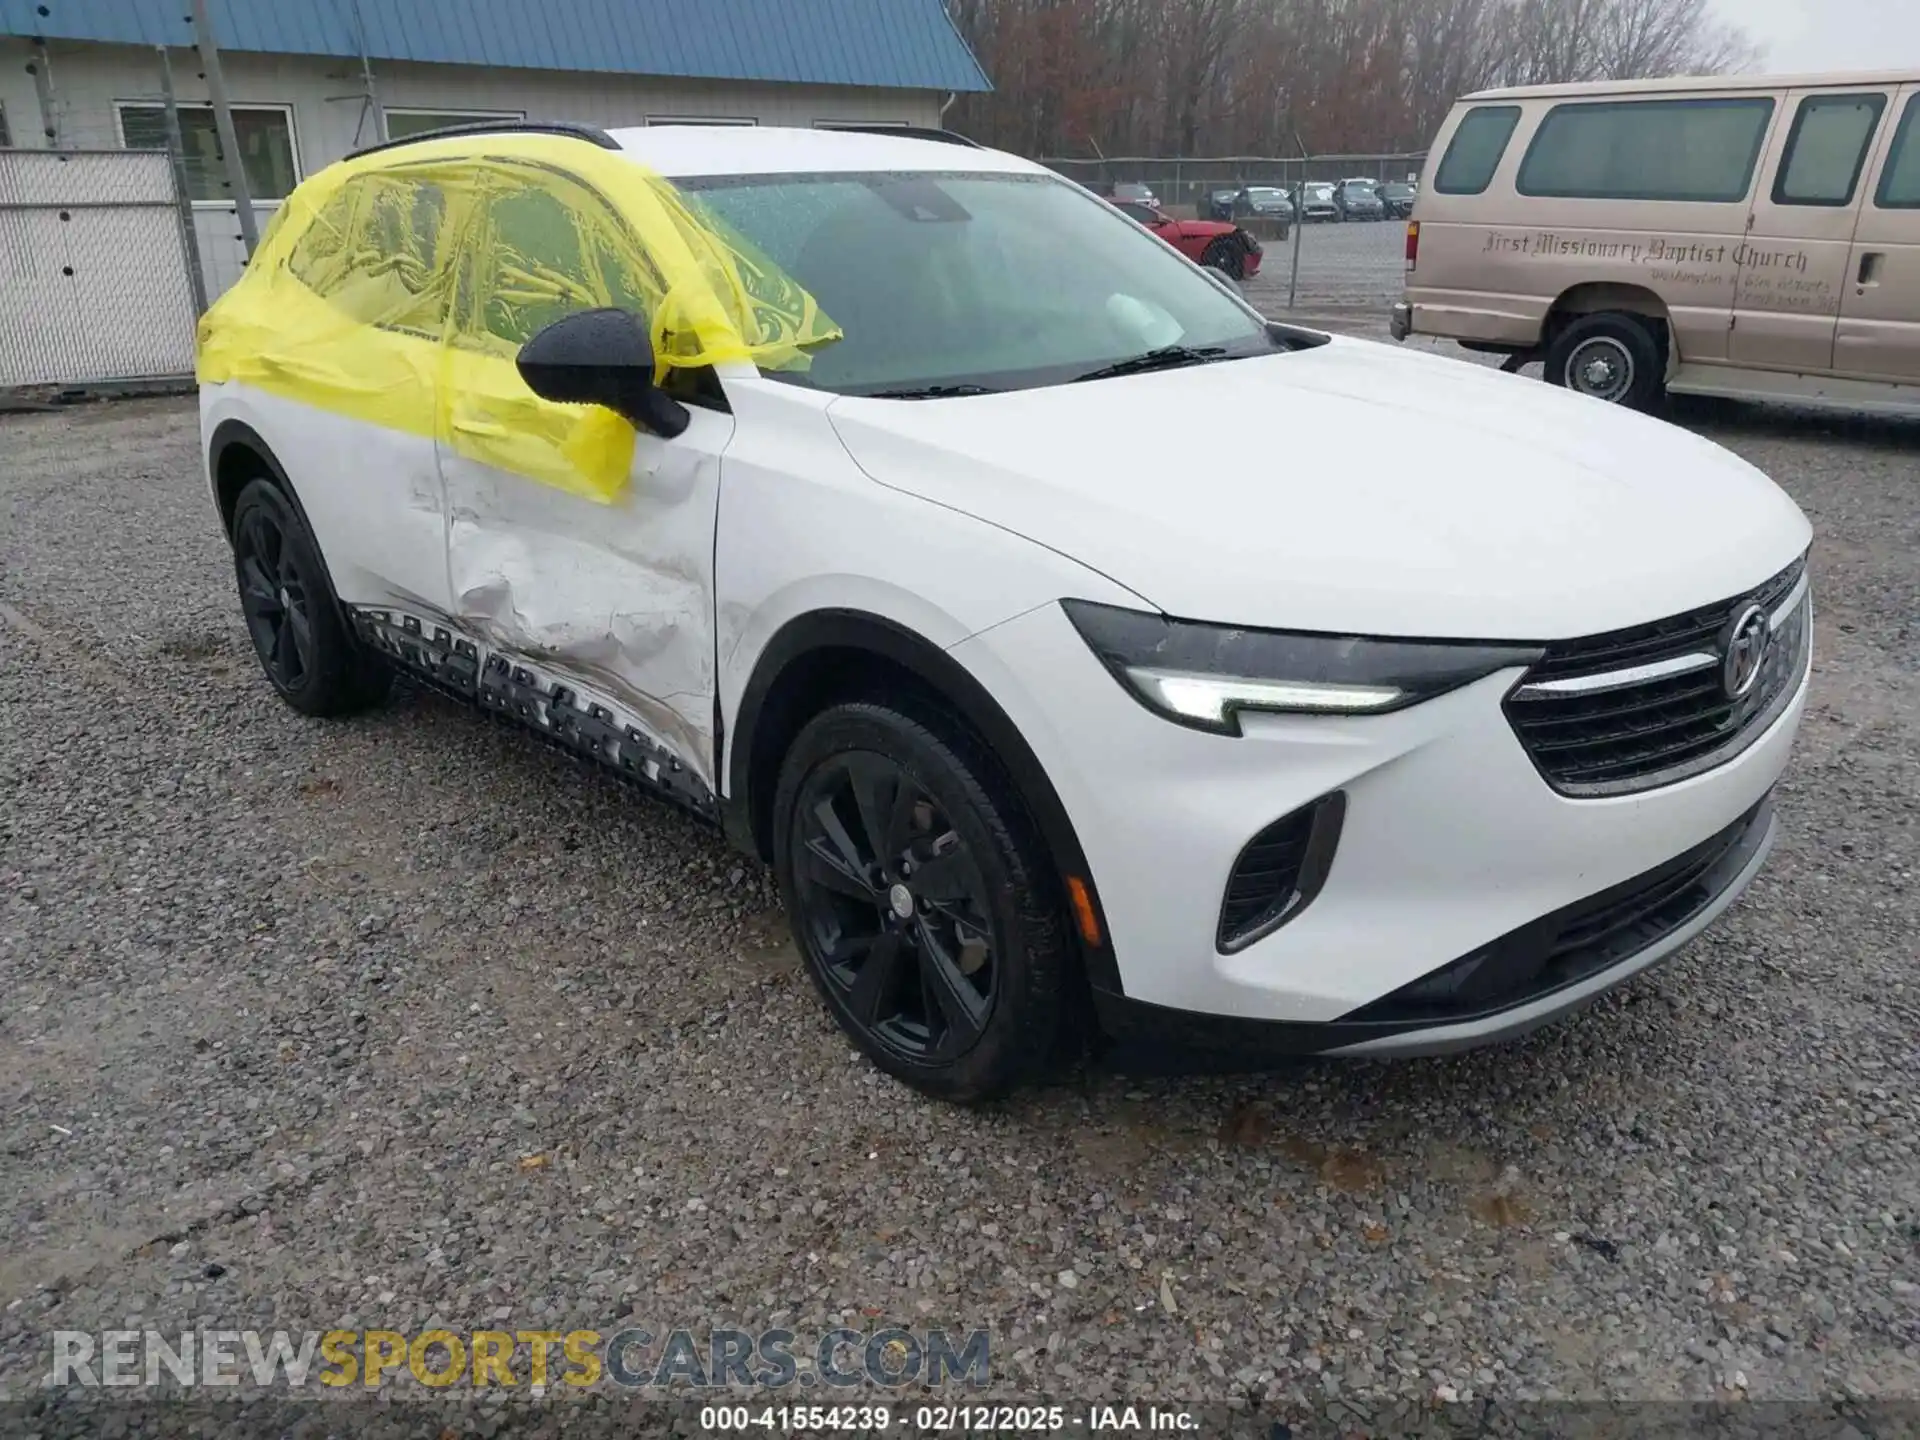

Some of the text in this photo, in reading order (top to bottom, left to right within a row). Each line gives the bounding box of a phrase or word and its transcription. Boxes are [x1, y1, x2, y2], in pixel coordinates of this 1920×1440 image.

[1482, 231, 1808, 273] First Missionary Baptist Church
